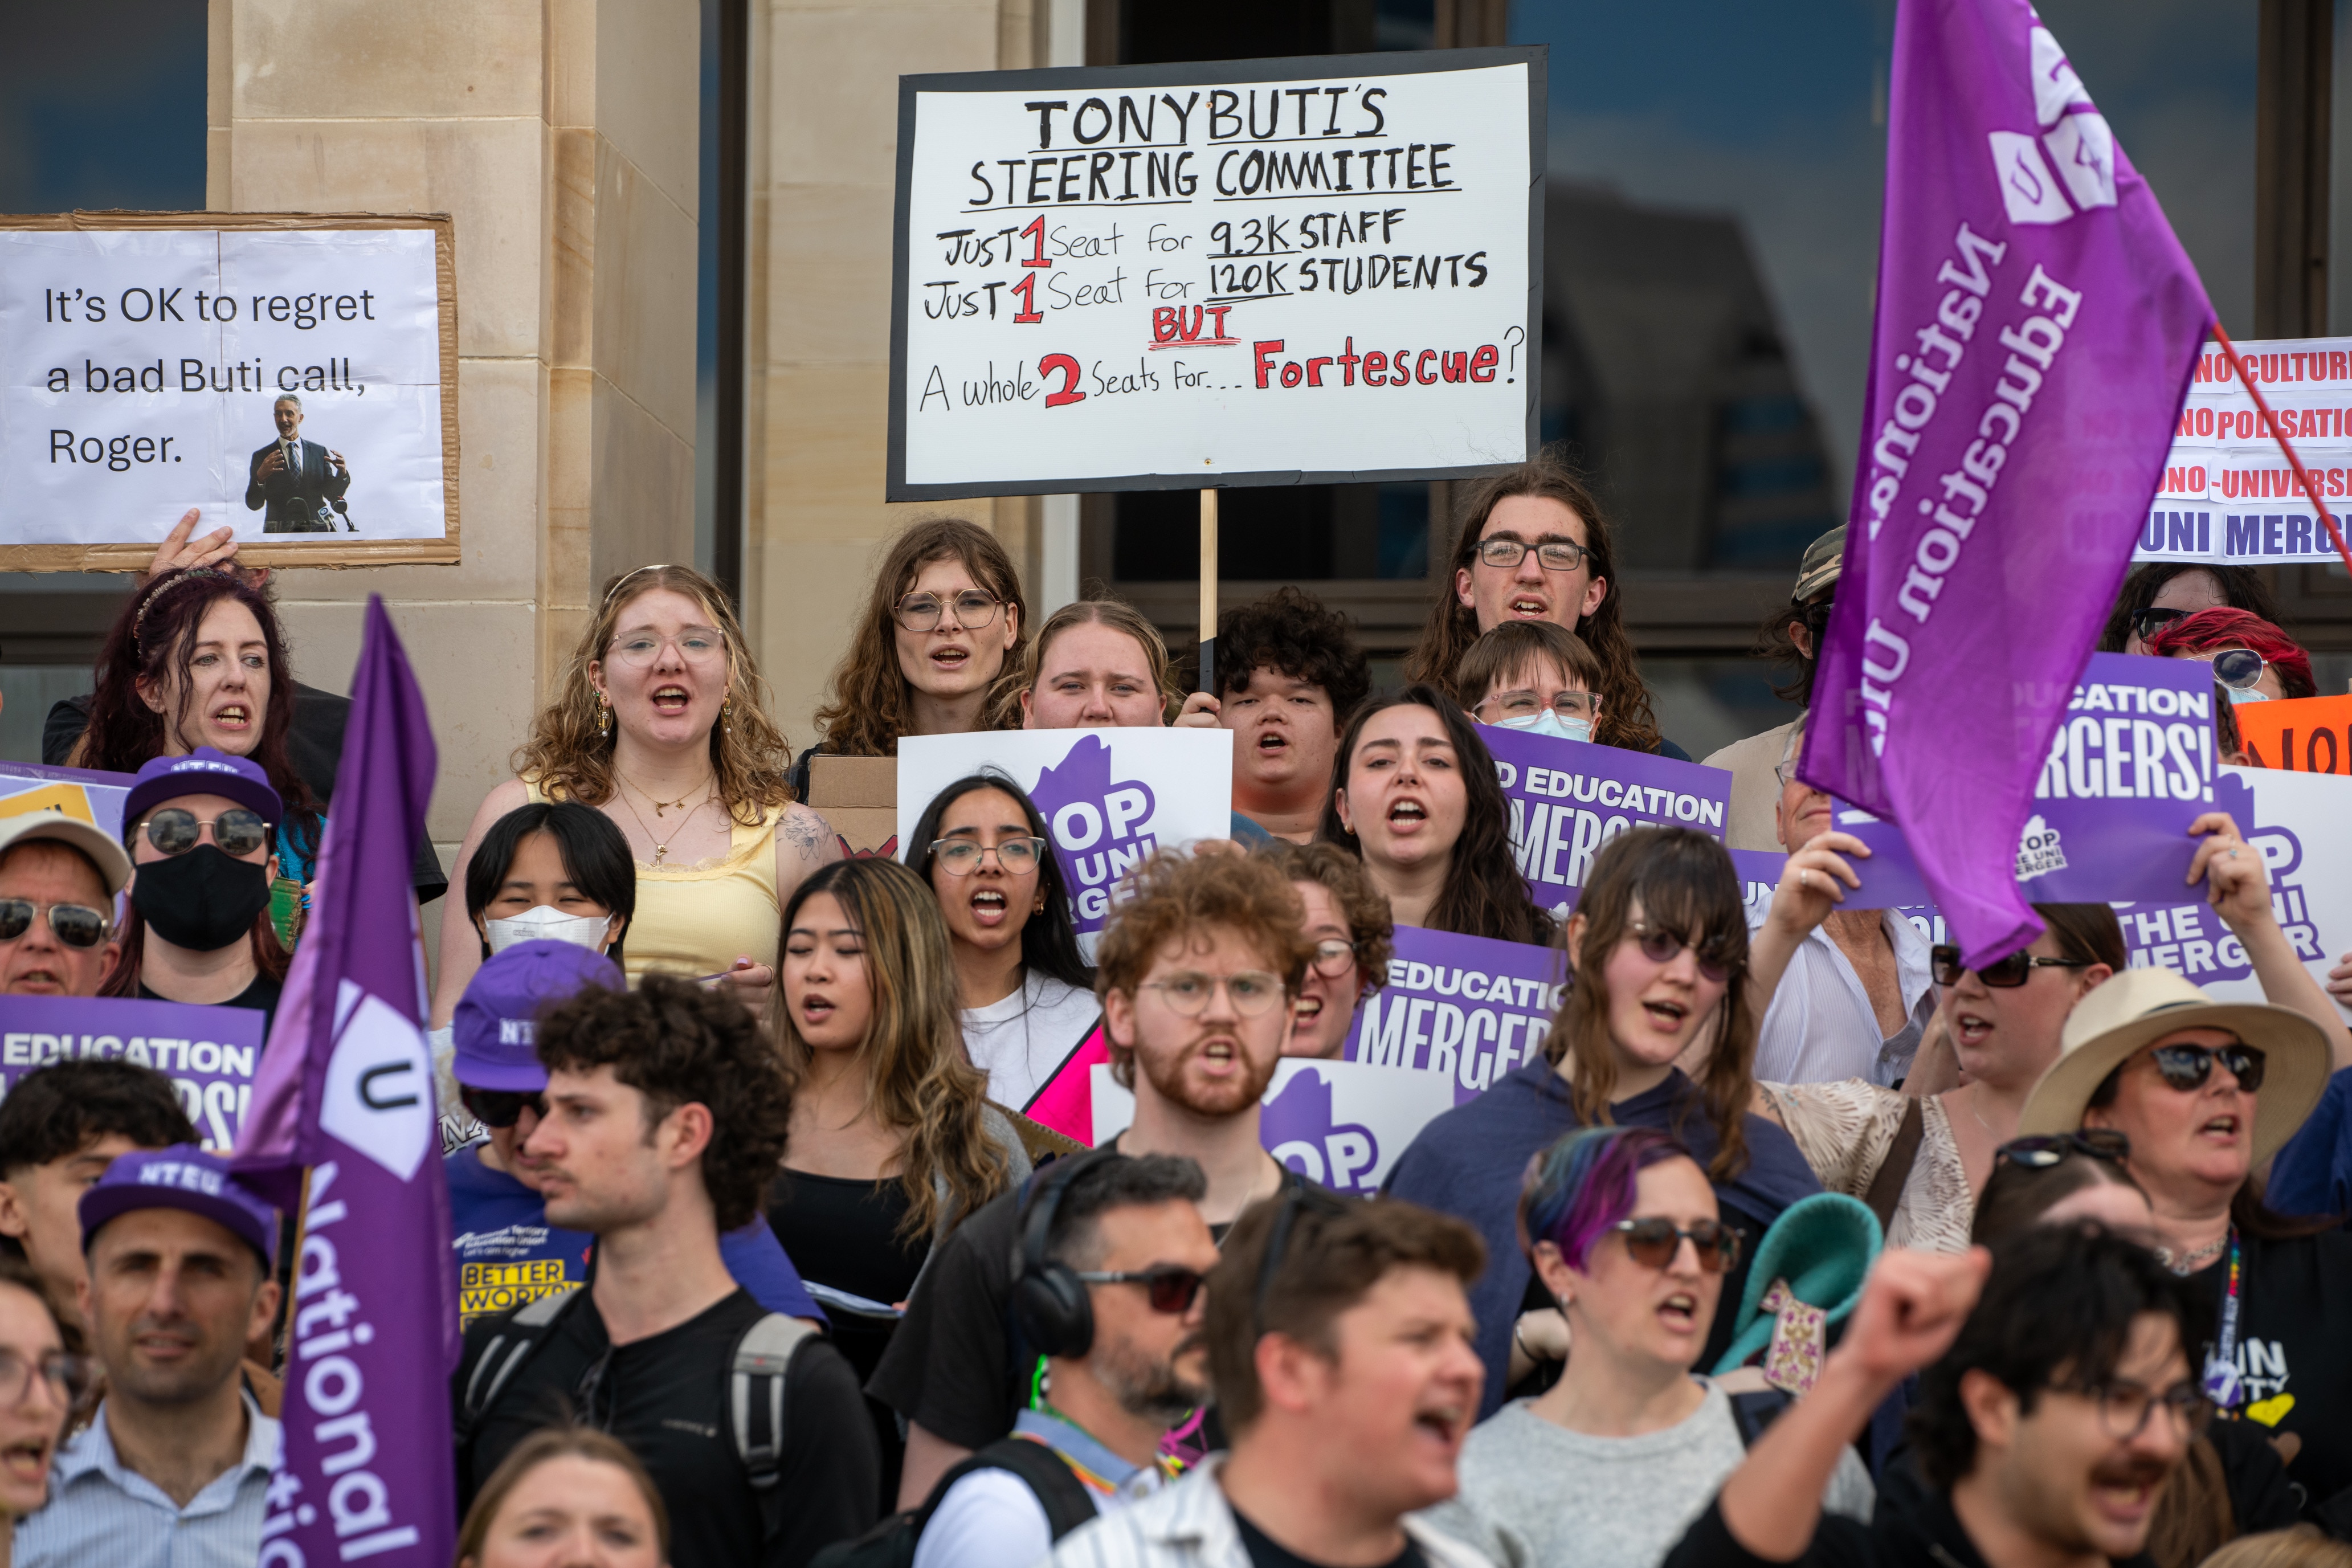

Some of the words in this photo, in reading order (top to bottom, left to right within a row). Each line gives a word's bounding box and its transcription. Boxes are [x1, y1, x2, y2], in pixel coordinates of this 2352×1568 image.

[1024, 91, 1200, 149] TONY
[1209, 84, 1388, 140] BUTI'S
[969, 151, 1198, 205] STEERING
[1216, 144, 1456, 196] COMMITTEE
[936, 226, 1019, 267] JUST
[1019, 214, 1053, 268] 1
[1050, 222, 1125, 258] Seat
[1300, 208, 1407, 249] STAFF
[46, 288, 107, 323] It’s
[120, 287, 185, 322] OK
[194, 289, 238, 322] to
[252, 289, 375, 330] regret
[923, 281, 1007, 321] JUST
[1010, 271, 1044, 324] 1
[1048, 266, 1128, 309] Seat
[1210, 260, 1289, 294] 120K
[1299, 251, 1488, 295] STUDENTS
[1153, 304, 1232, 341] BUT
[47, 369, 70, 393] a
[86, 358, 165, 393] bad
[181, 357, 262, 393] Buti
[277, 357, 366, 397] call,
[920, 365, 950, 411] A
[963, 360, 1040, 406] whole
[1038, 353, 1086, 409] 2
[1092, 357, 1159, 397] Seats
[1253, 325, 1525, 389] Fortescue?
[2240, 350, 2352, 383] CULTUR
[50, 428, 182, 472] Roger.
[2139, 511, 2210, 552] UNI
[2067, 683, 2210, 719] CATION
[2034, 716, 2214, 803] RGERS!
[1524, 765, 1724, 828] EDUCATION
[1038, 787, 1147, 851] OP
[2026, 832, 2056, 850] OP
[2015, 856, 2064, 875] ERGER
[3, 1032, 255, 1077] EDUCATION
[138, 1161, 224, 1195] NTEU
[1270, 1131, 1371, 1189] OP
[465, 1262, 561, 1285] BETTER
